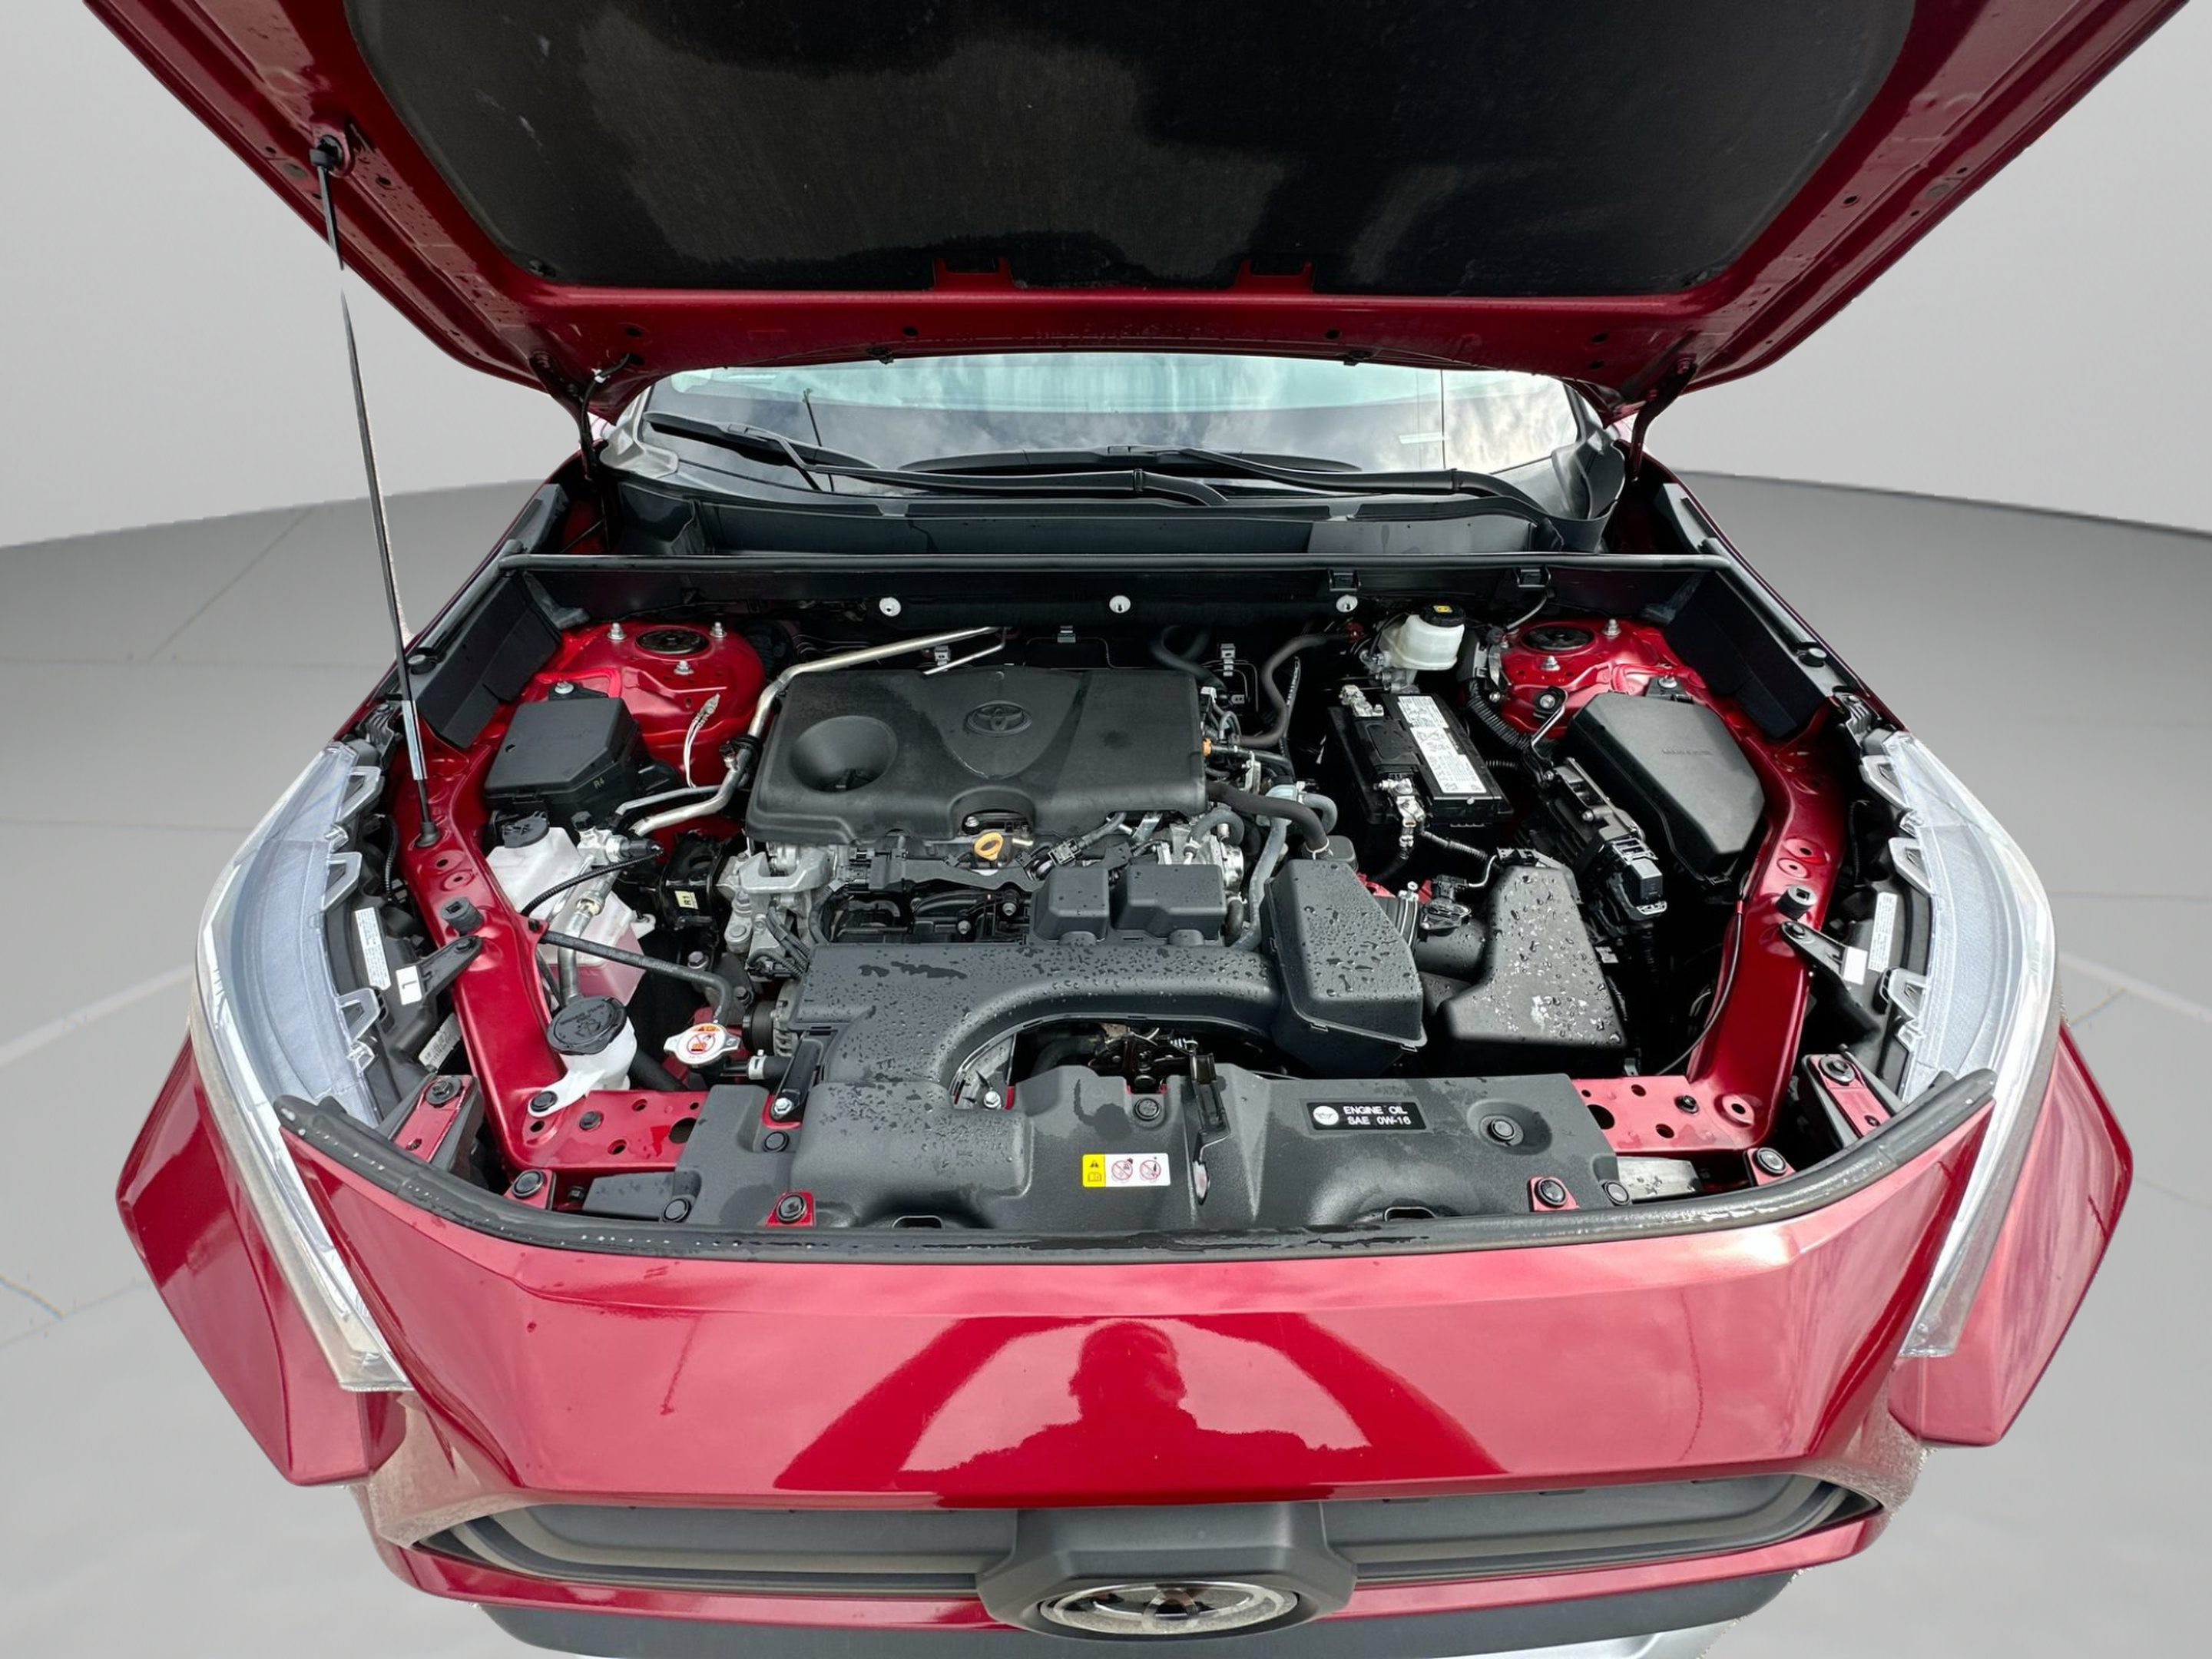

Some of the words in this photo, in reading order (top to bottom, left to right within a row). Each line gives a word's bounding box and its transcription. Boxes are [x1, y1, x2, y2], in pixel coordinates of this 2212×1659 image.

[1343, 1106, 1383, 1114] ENGINE
[1388, 1106, 1408, 1114] OIL
[1347, 1116, 1370, 1125] SAE
[1376, 1116, 1412, 1125] 0W-16
